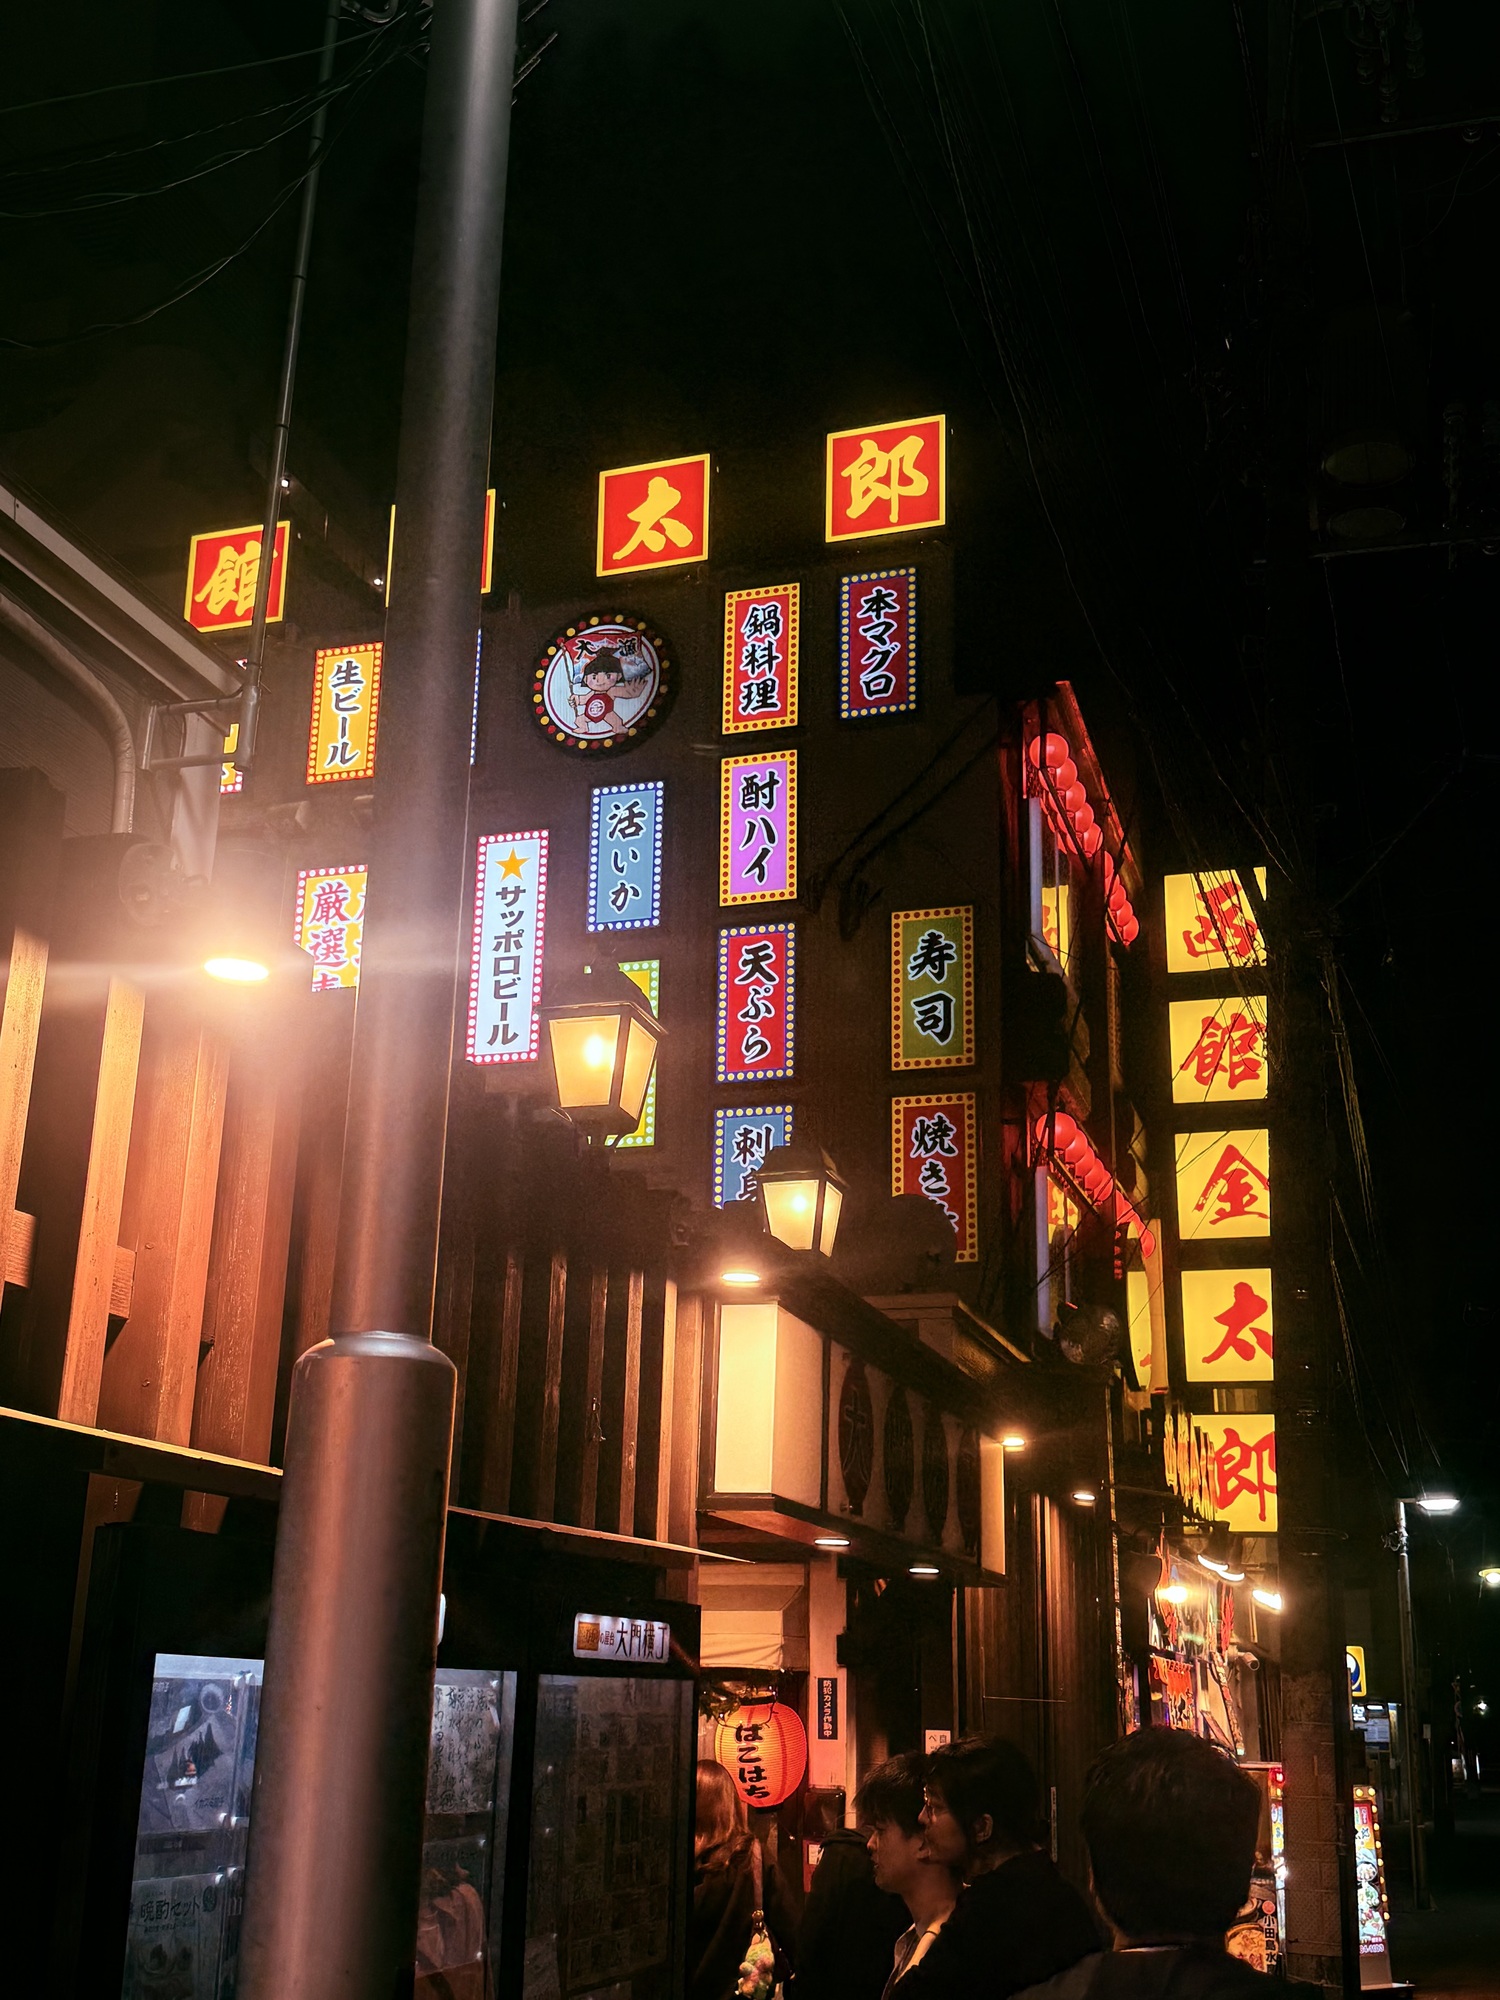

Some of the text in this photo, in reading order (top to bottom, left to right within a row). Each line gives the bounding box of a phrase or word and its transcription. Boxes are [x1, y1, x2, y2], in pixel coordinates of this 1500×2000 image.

[741, 603, 782, 715] 鍋料理
[858, 588, 899, 699] 本マグロ
[326, 659, 365, 767] 生ビール
[608, 799, 646, 913] 活いか
[739, 772, 780, 885] 酎ハイ
[487, 884, 526, 1047] サッポロビール
[734, 941, 780, 1064] 天ぷら
[909, 930, 956, 1045] 寿司
[614, 1621, 668, 1659] 大門横丁
[735, 1723, 771, 1799] はこはち
[822, 1679, 833, 1738] 防犯カメラ作動中
[141, 1895, 200, 1922] 晩酌セット
